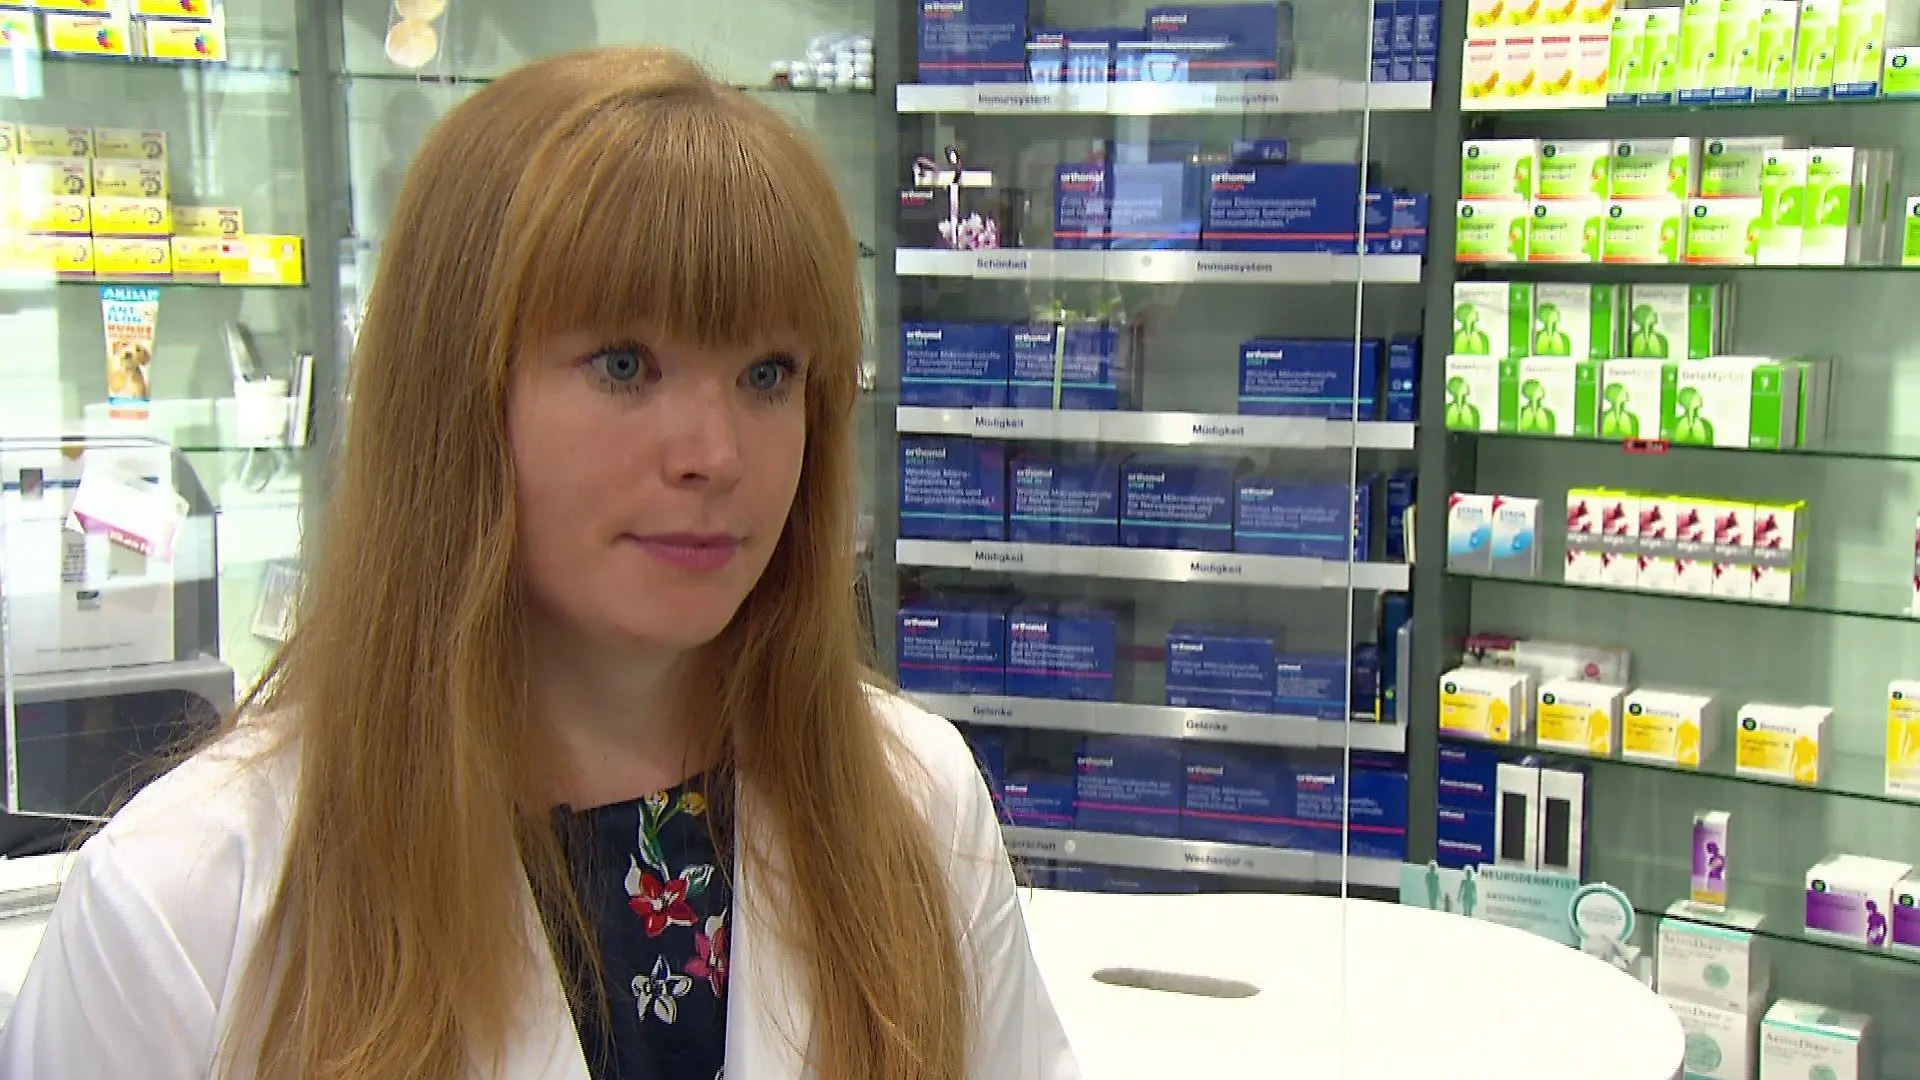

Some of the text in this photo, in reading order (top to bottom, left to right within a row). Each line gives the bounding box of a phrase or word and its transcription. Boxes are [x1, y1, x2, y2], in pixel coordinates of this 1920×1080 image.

[978, 94, 1050, 106] Immunsystem
[1211, 171, 1255, 183] orthomol
[977, 258, 1027, 270] Schönheit
[1197, 261, 1273, 274] Immunsystem
[907, 329, 942, 340] orthomol
[1015, 333, 1050, 342] orthomol
[975, 416, 1023, 429] Müdigkeit
[1192, 424, 1244, 437] Müdigkeit
[906, 447, 946, 458] orthomol
[1017, 468, 1052, 478] orthomol
[1128, 473, 1165, 483] orthomol
[975, 551, 1023, 564] Müdigkeit
[1190, 562, 1241, 576] Müdigkeit
[904, 618, 939, 629] orthomol
[1012, 622, 1047, 633] orthomol
[972, 705, 1013, 717] Gelenke
[1186, 720, 1228, 732] Gelenke
